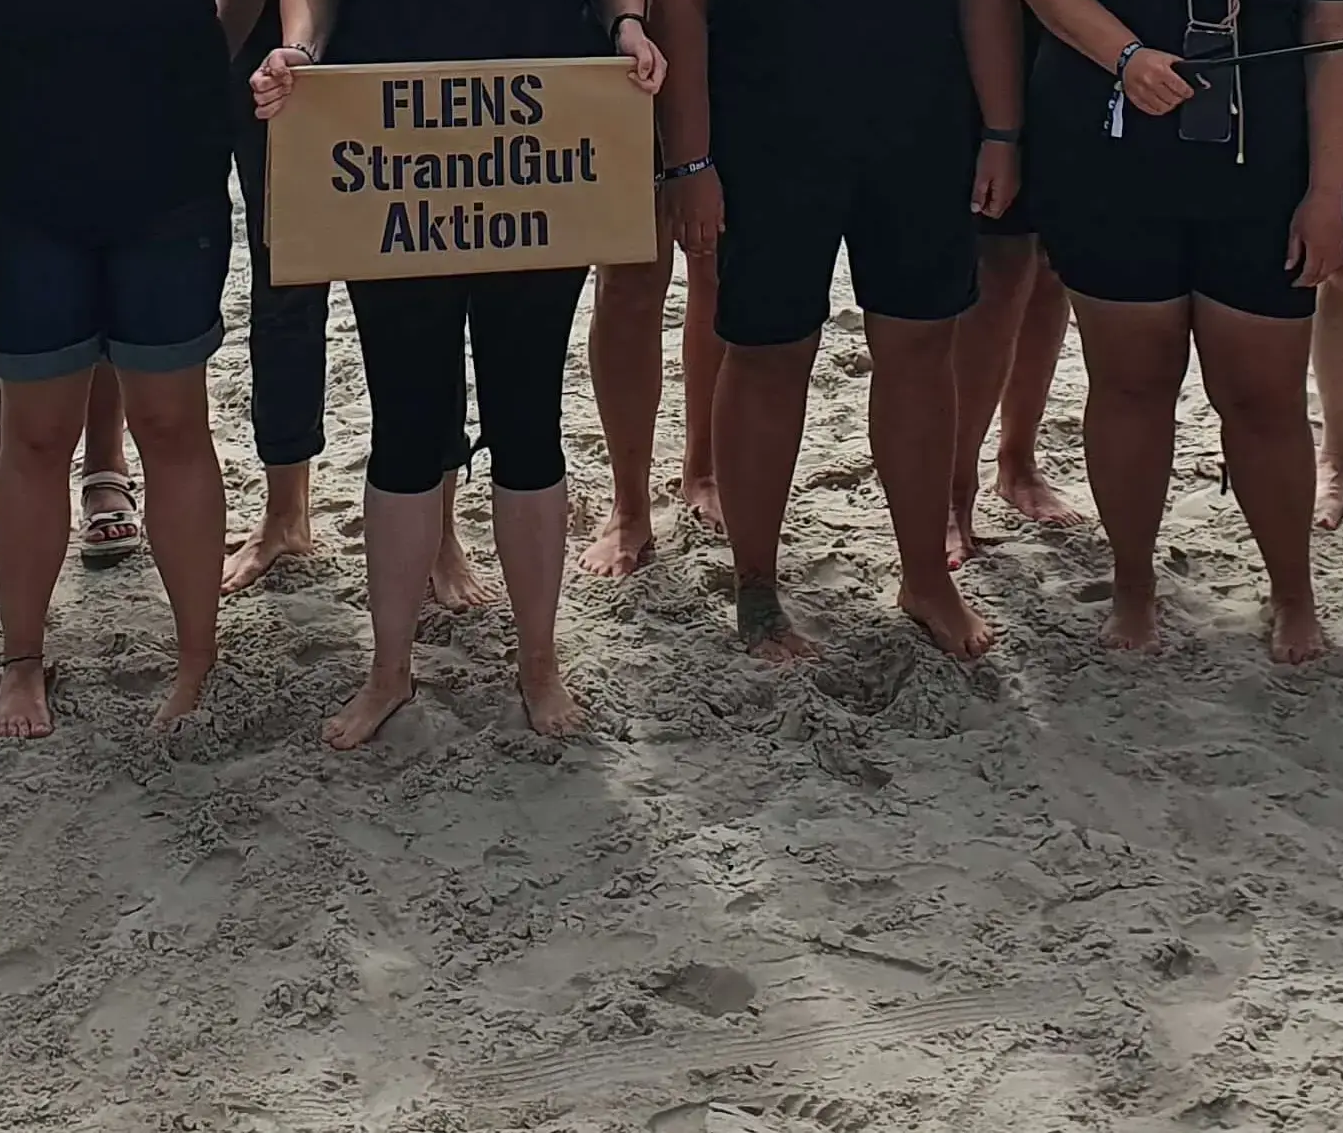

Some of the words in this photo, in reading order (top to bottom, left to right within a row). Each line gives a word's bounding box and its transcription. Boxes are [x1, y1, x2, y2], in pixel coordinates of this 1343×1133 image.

[382, 74, 544, 130] FLENS
[331, 135, 598, 194] StrandGut
[380, 200, 550, 255] Aktion
